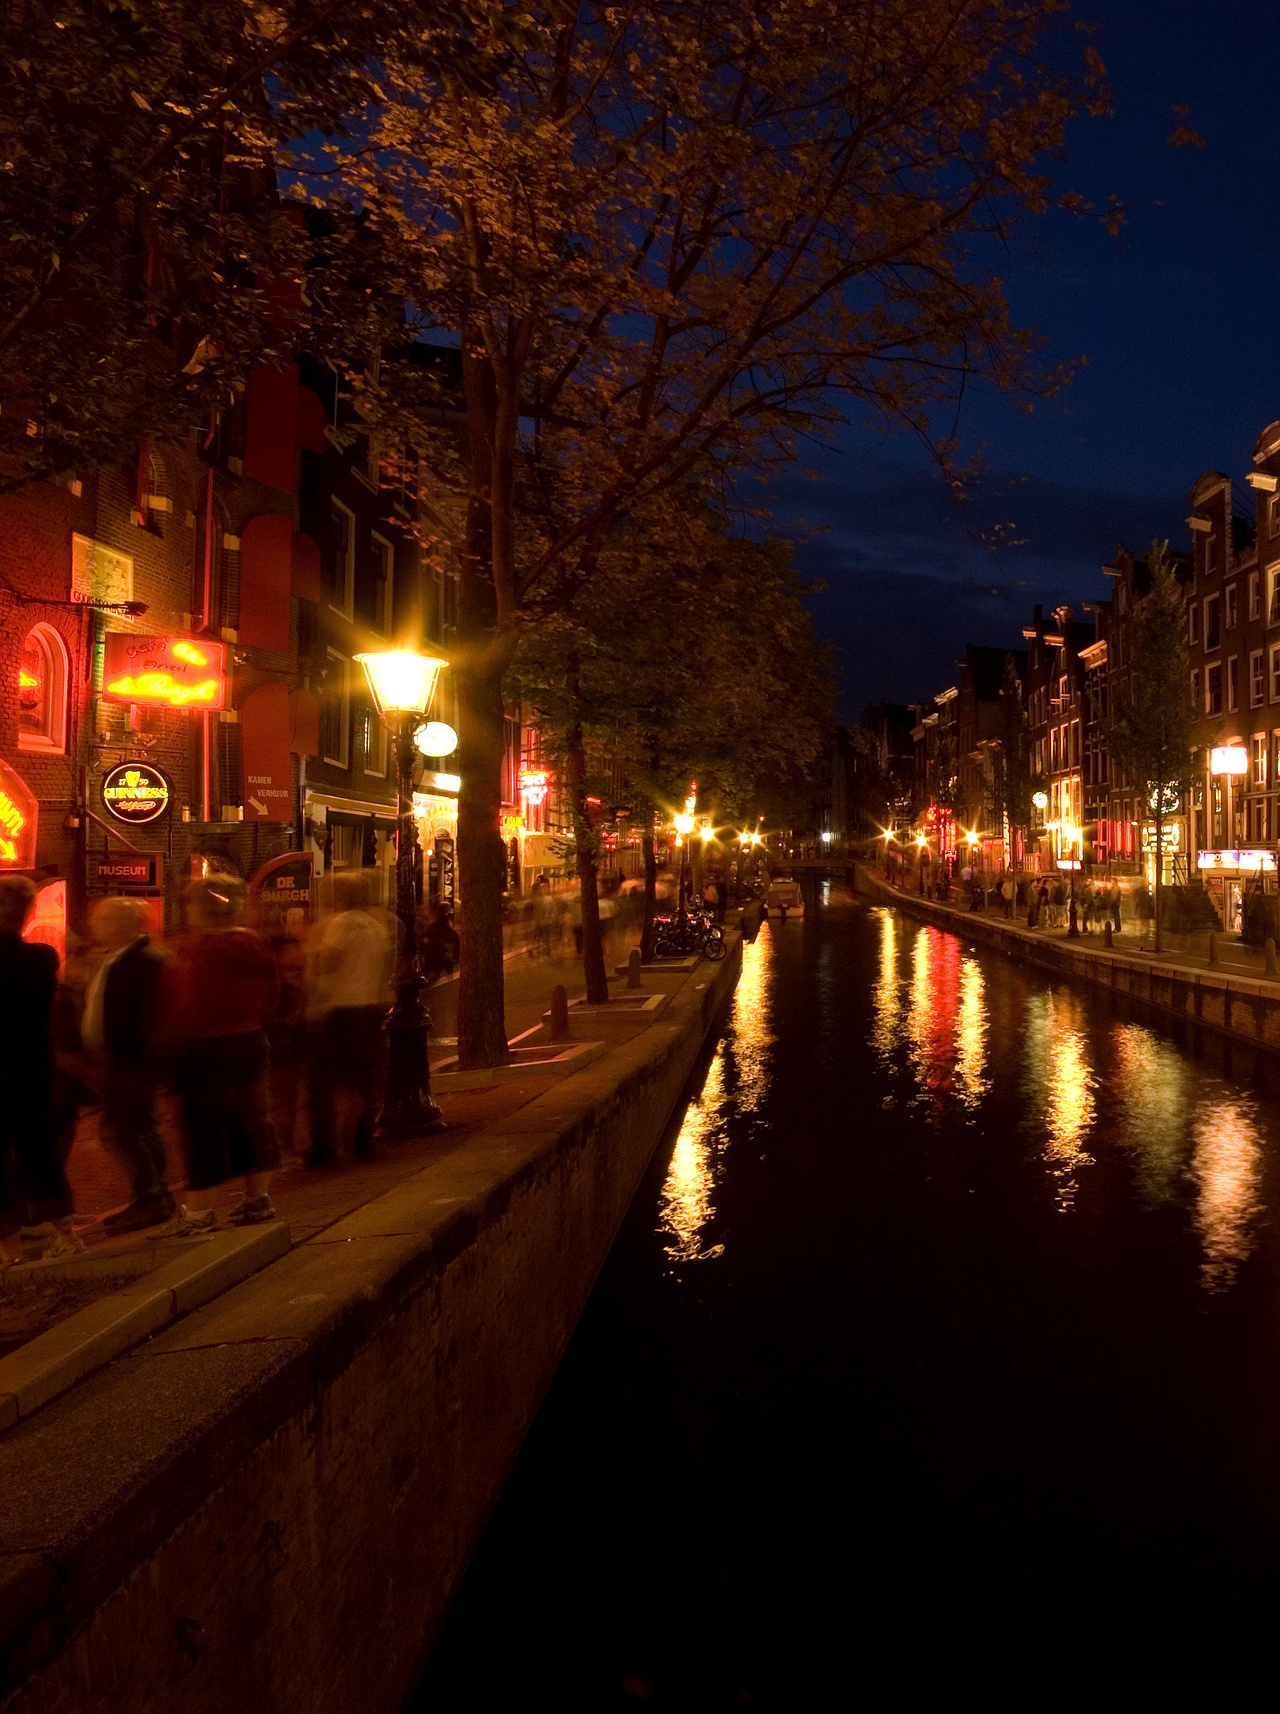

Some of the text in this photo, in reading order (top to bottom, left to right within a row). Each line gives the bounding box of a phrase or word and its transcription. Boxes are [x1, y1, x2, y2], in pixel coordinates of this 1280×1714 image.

[135, 673, 218, 705] Burgh
[247, 775, 272, 785] KAMER
[104, 787, 169, 799] GUINNESS
[257, 789, 289, 798] VERHUUR
[98, 865, 146, 876] MUSEUM
[276, 876, 295, 889] DE
